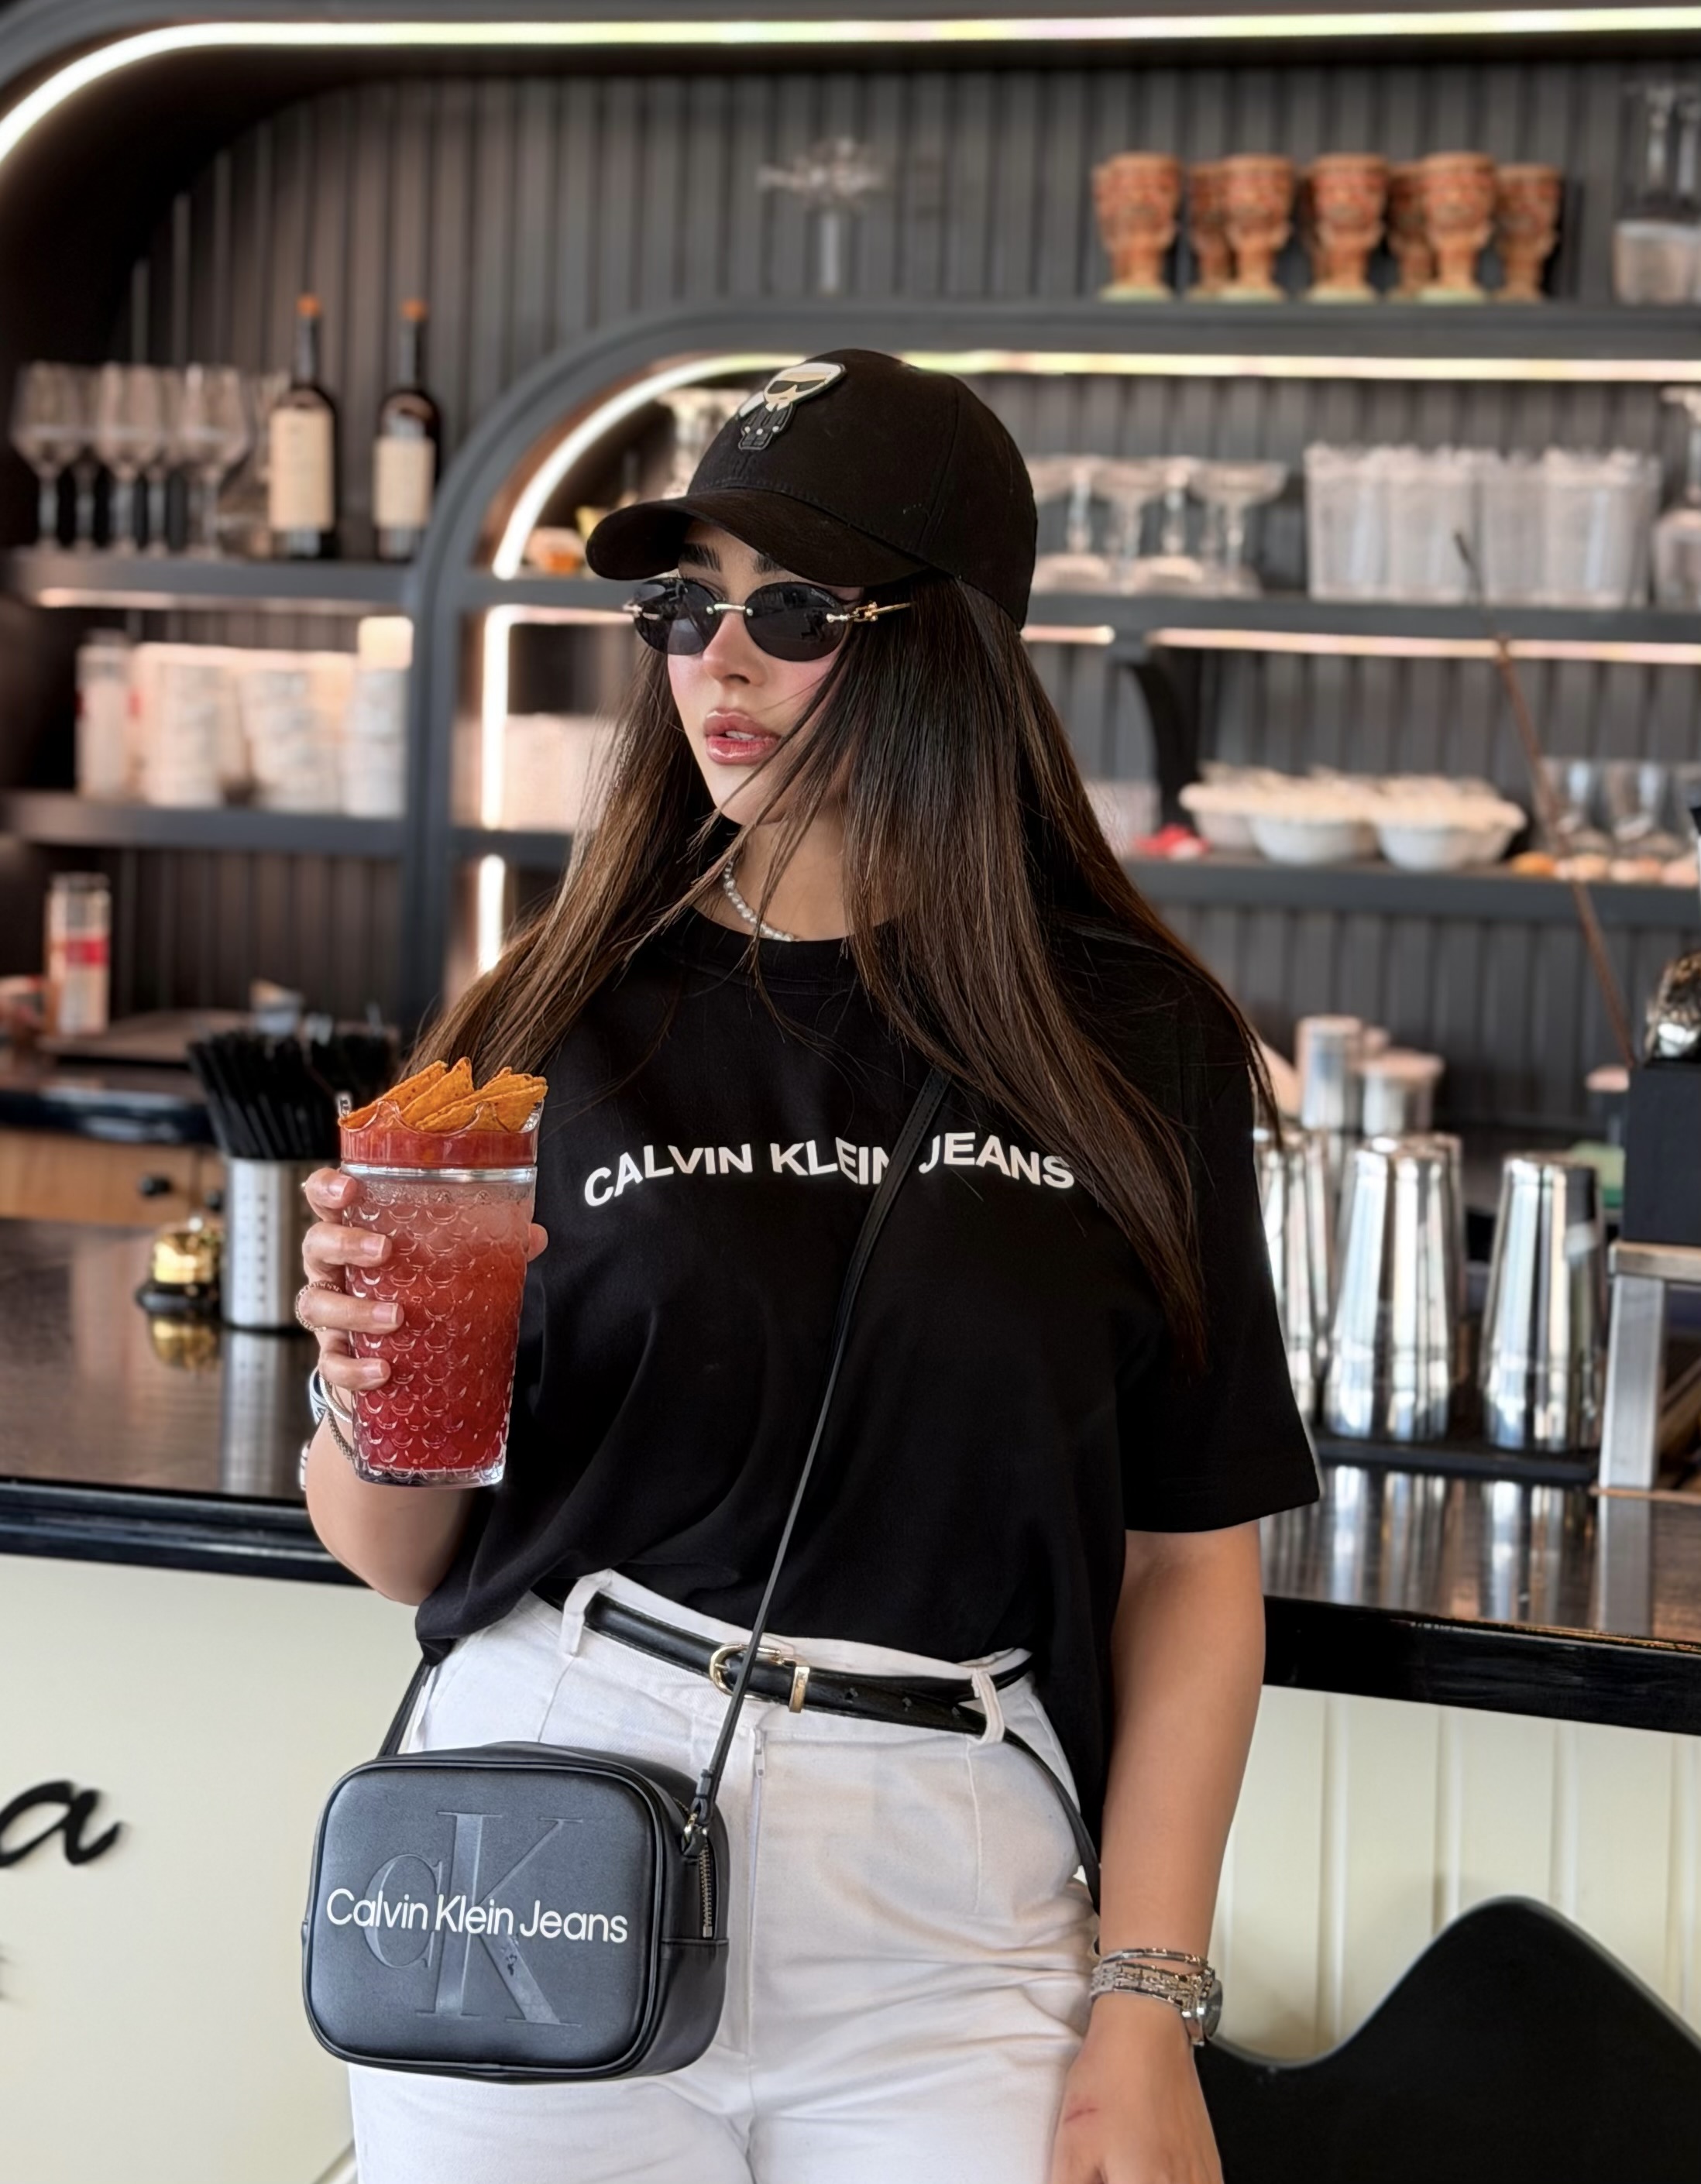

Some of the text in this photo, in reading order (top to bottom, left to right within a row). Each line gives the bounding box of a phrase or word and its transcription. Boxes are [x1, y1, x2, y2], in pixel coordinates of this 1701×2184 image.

[584, 1143, 753, 1207] CALVIN
[918, 1131, 1074, 1189] JEANS
[326, 1887, 628, 1944] Calvin Klein Jeans
